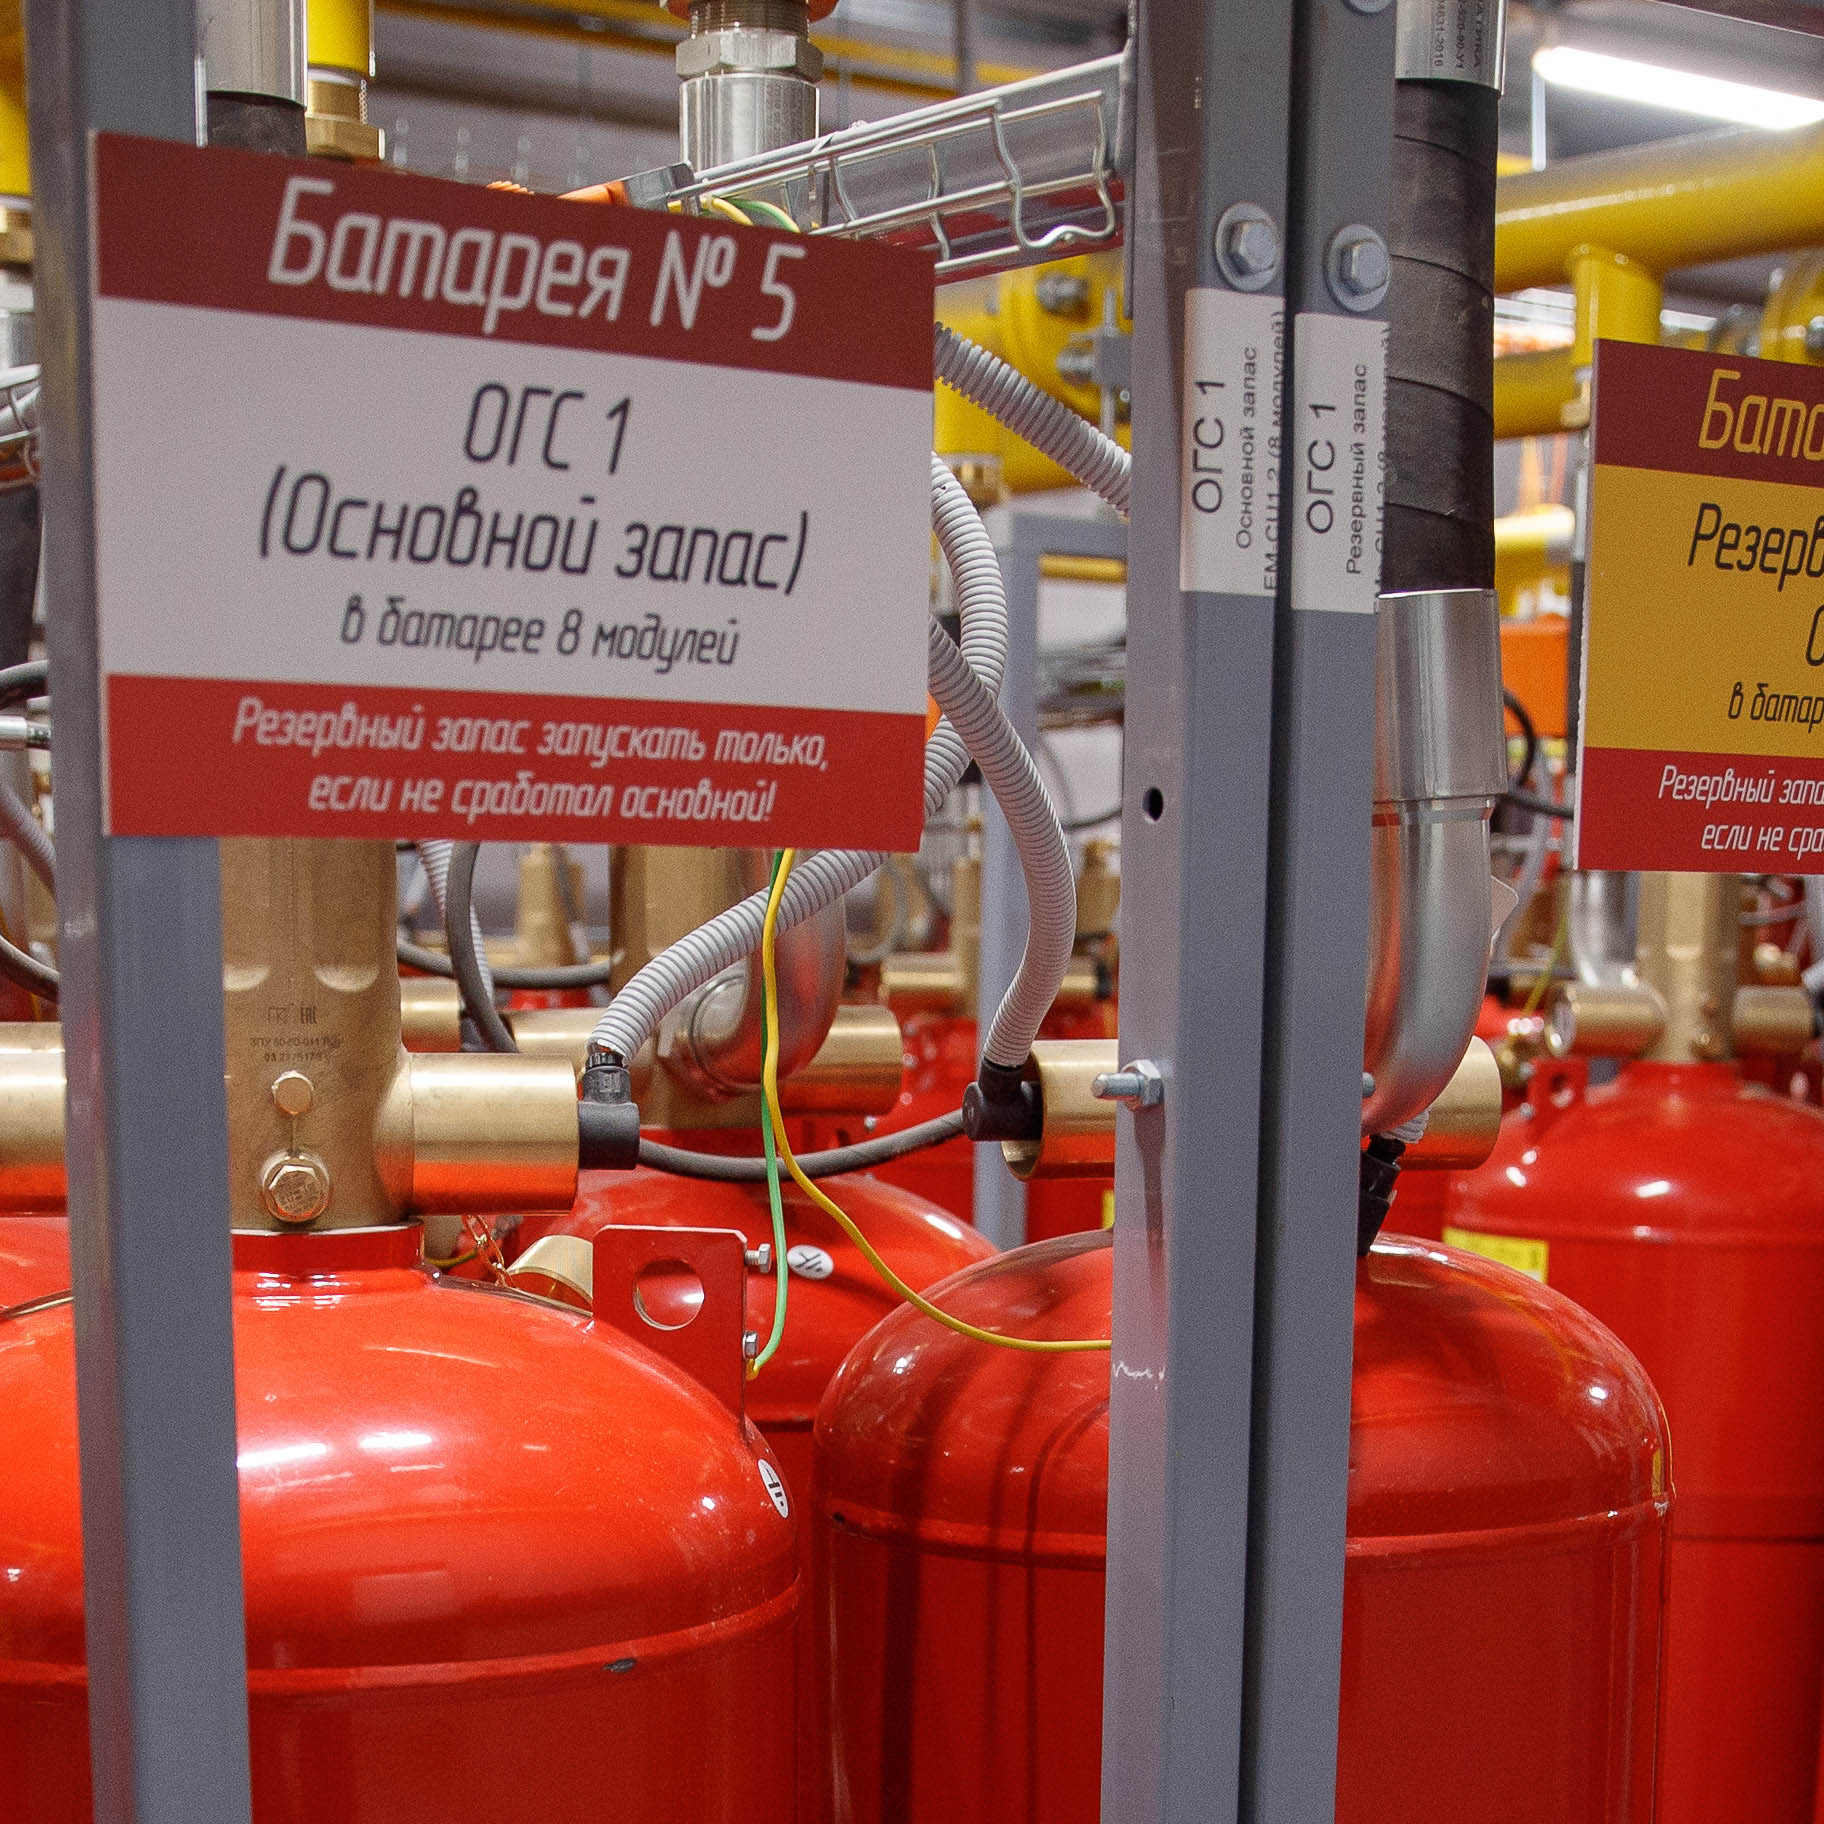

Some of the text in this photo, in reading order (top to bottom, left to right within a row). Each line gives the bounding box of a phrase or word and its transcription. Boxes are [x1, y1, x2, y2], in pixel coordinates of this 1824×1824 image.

[267, 175, 631, 335] Батарея
[752, 245, 805, 342] 5
[464, 383, 631, 475] ОГС 1
[1192, 381, 1225, 513] ОГС 1
[1235, 346, 1257, 549] Основной запас
[1306, 403, 1336, 534] ОГС 1
[1347, 364, 1367, 575] Резервный запас
[260, 465, 808, 596] (Основной запас)
[342, 594, 740, 674] в батарее 8 модулей
[234, 697, 828, 771] Резервный запас запускать только,
[1728, 682, 1742, 720] в
[308, 774, 775, 823] если не сработал основной!
[1659, 765, 1775, 807] Резервный
[1702, 823, 1751, 850] если
[1756, 827, 1781, 851] не
